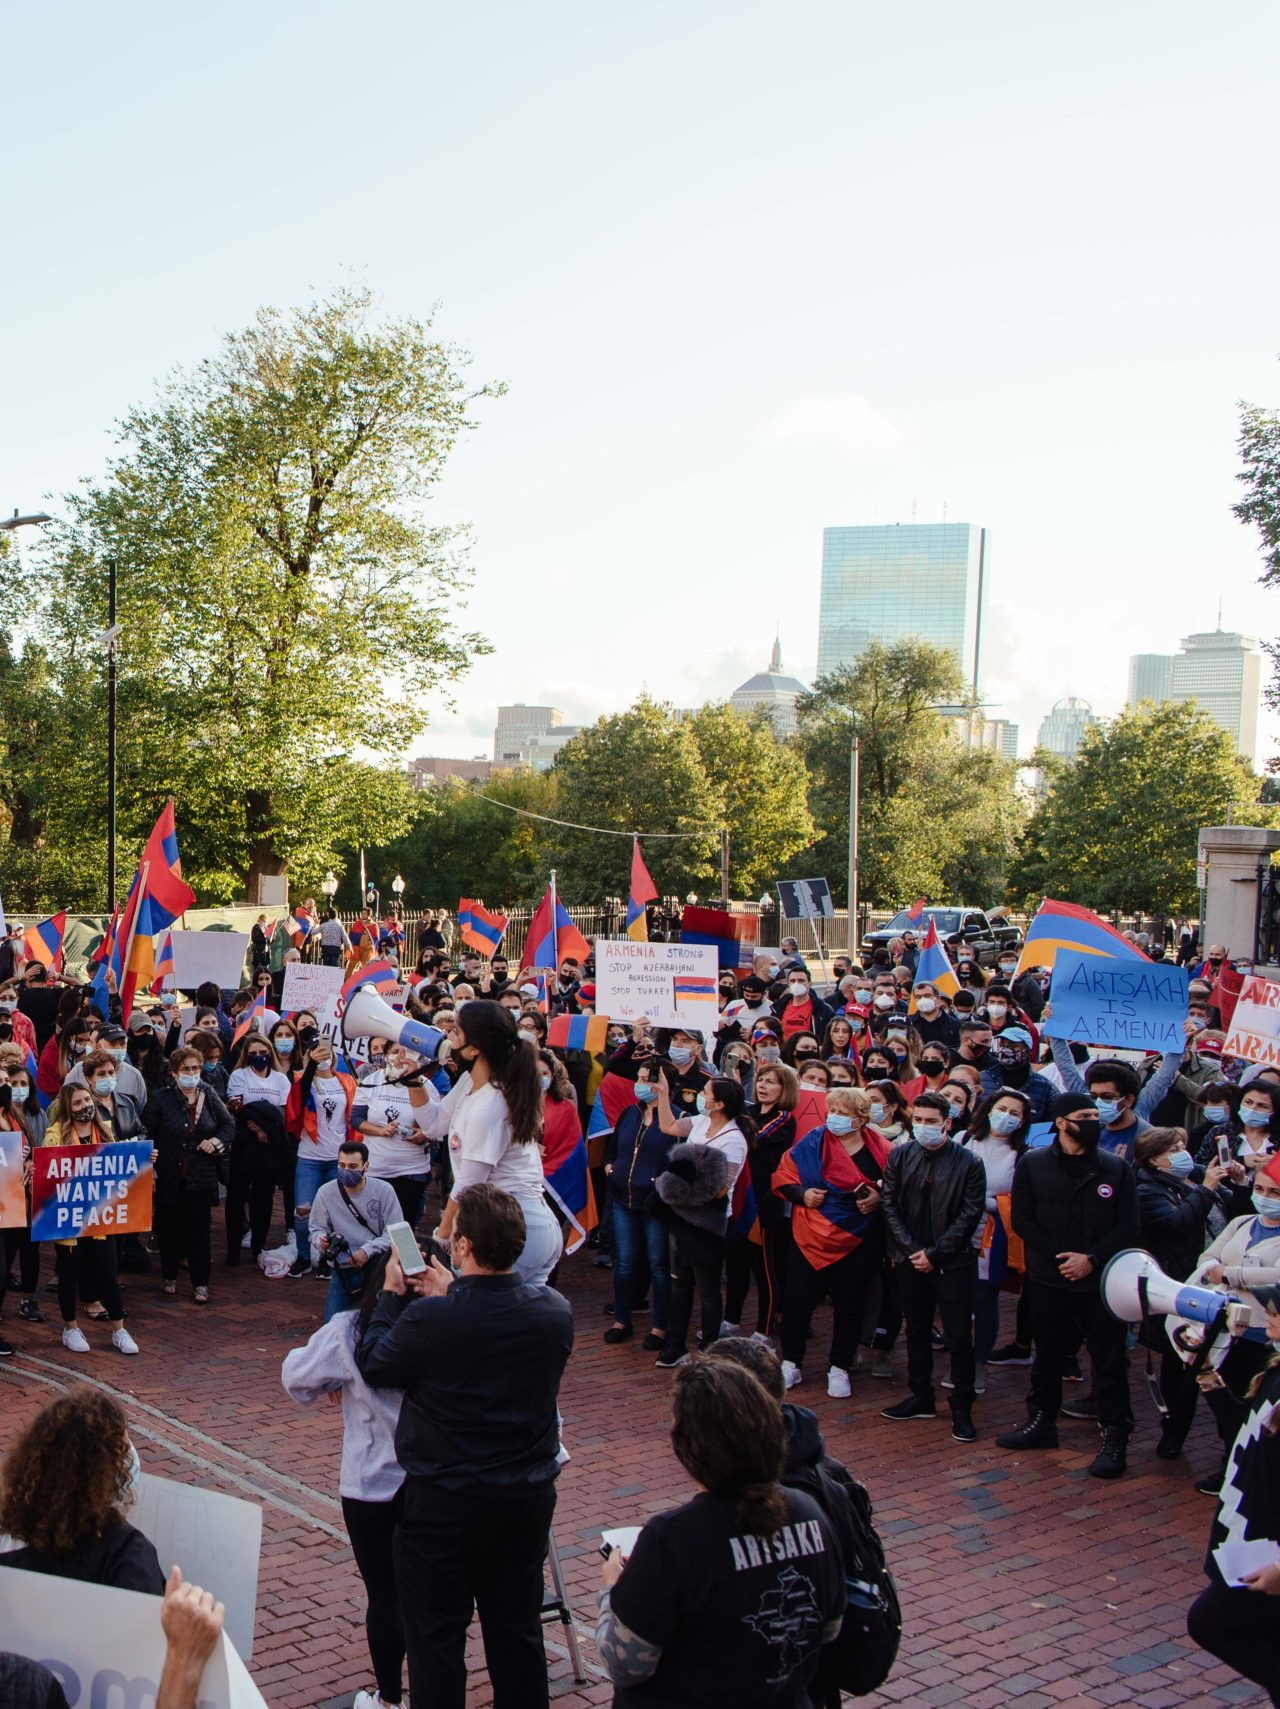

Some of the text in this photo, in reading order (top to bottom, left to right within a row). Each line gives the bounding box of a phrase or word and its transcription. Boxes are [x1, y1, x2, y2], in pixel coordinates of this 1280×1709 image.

[605, 944, 704, 958] ARMENIA STRONG
[609, 963, 695, 974] STOP AZERBAIJANI
[629, 974, 666, 982] AGRESSION
[611, 987, 669, 997] STOP TURKEY
[1068, 962, 1185, 1003] ARTSAKH
[620, 1006, 634, 1015] We
[644, 1006, 659, 1017] will
[1098, 998, 1136, 1016] IS
[1070, 1016, 1179, 1044] ARMENIA
[47, 1155, 138, 1179] ARMENIA
[56, 1180, 128, 1202] WANTS
[57, 1204, 128, 1228] PEACE
[728, 1519, 825, 1571] ARTSAKH
